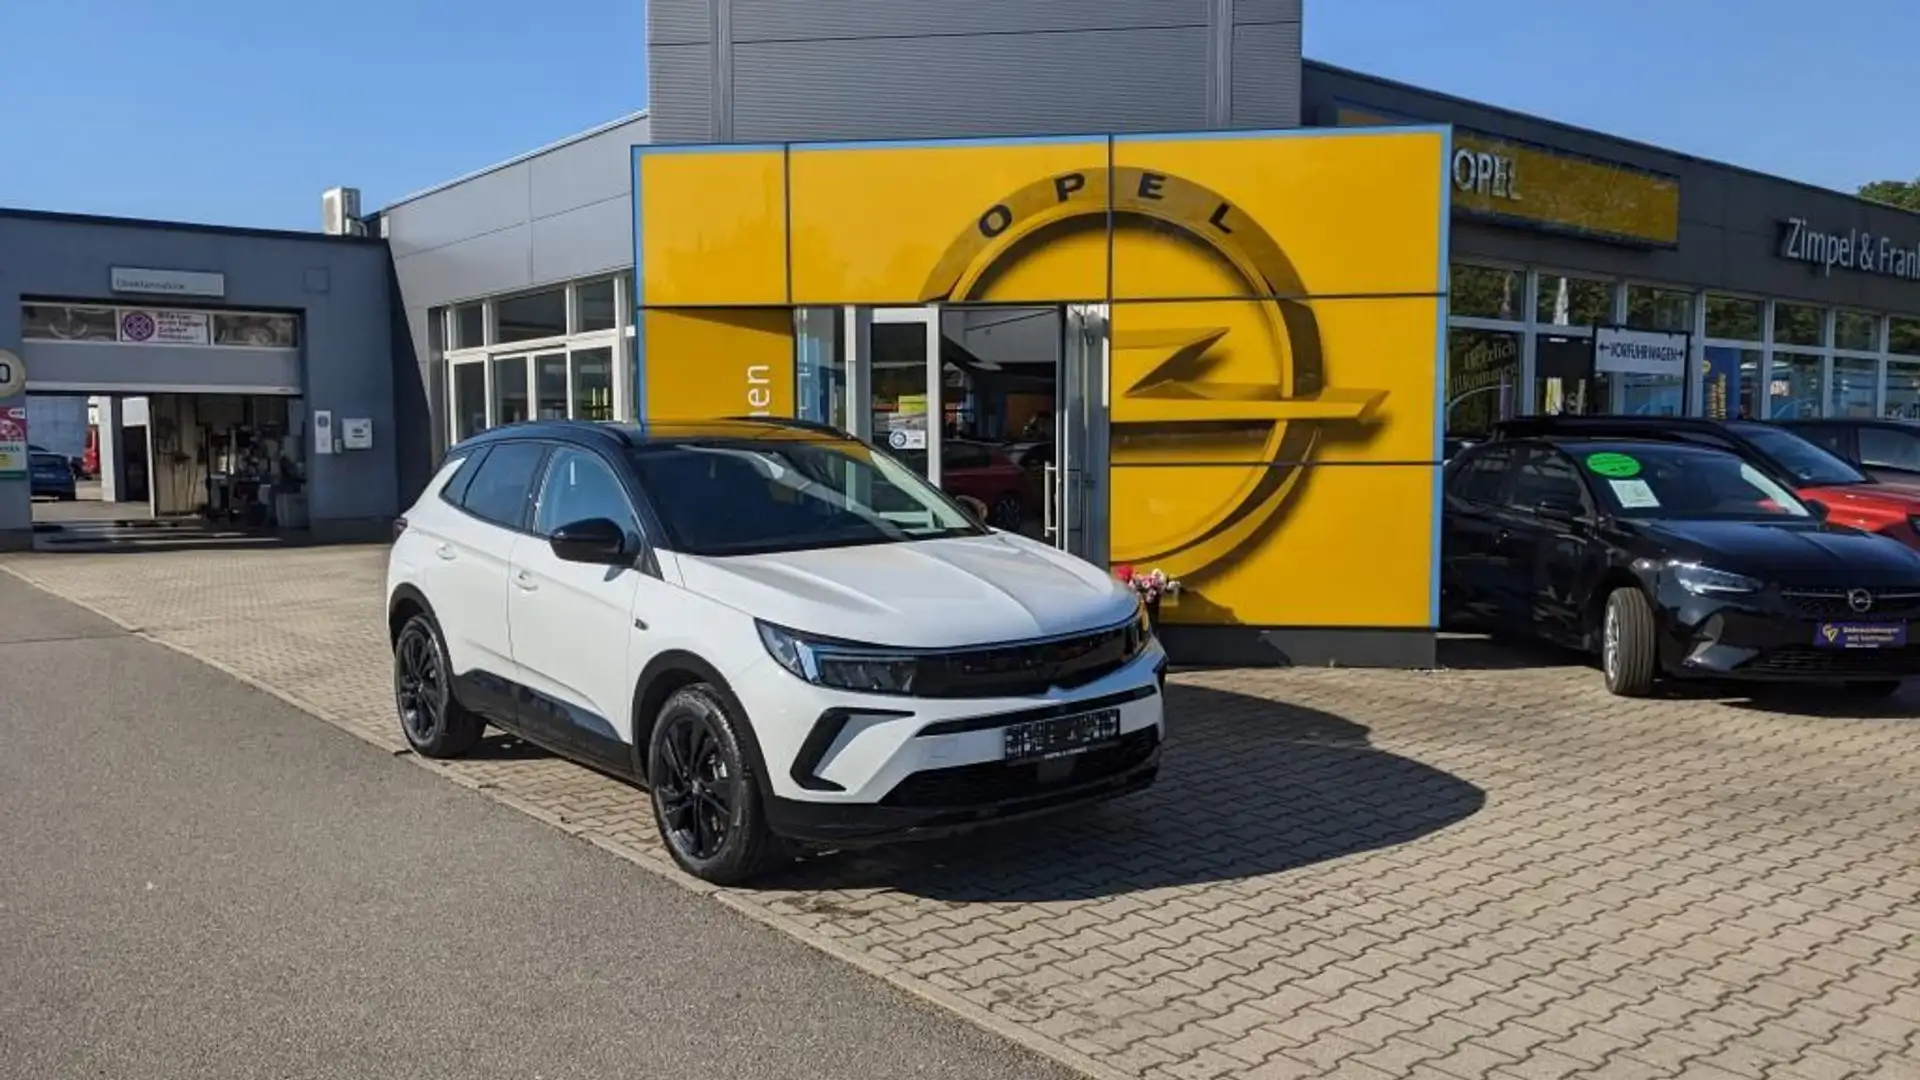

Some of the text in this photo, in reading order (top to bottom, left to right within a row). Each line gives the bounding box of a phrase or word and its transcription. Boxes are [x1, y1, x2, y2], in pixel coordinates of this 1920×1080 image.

[979, 172, 1235, 238] OPEL
[1453, 148, 1523, 200] OPEL
[1787, 217, 1920, 279] Zimpel & Fran
